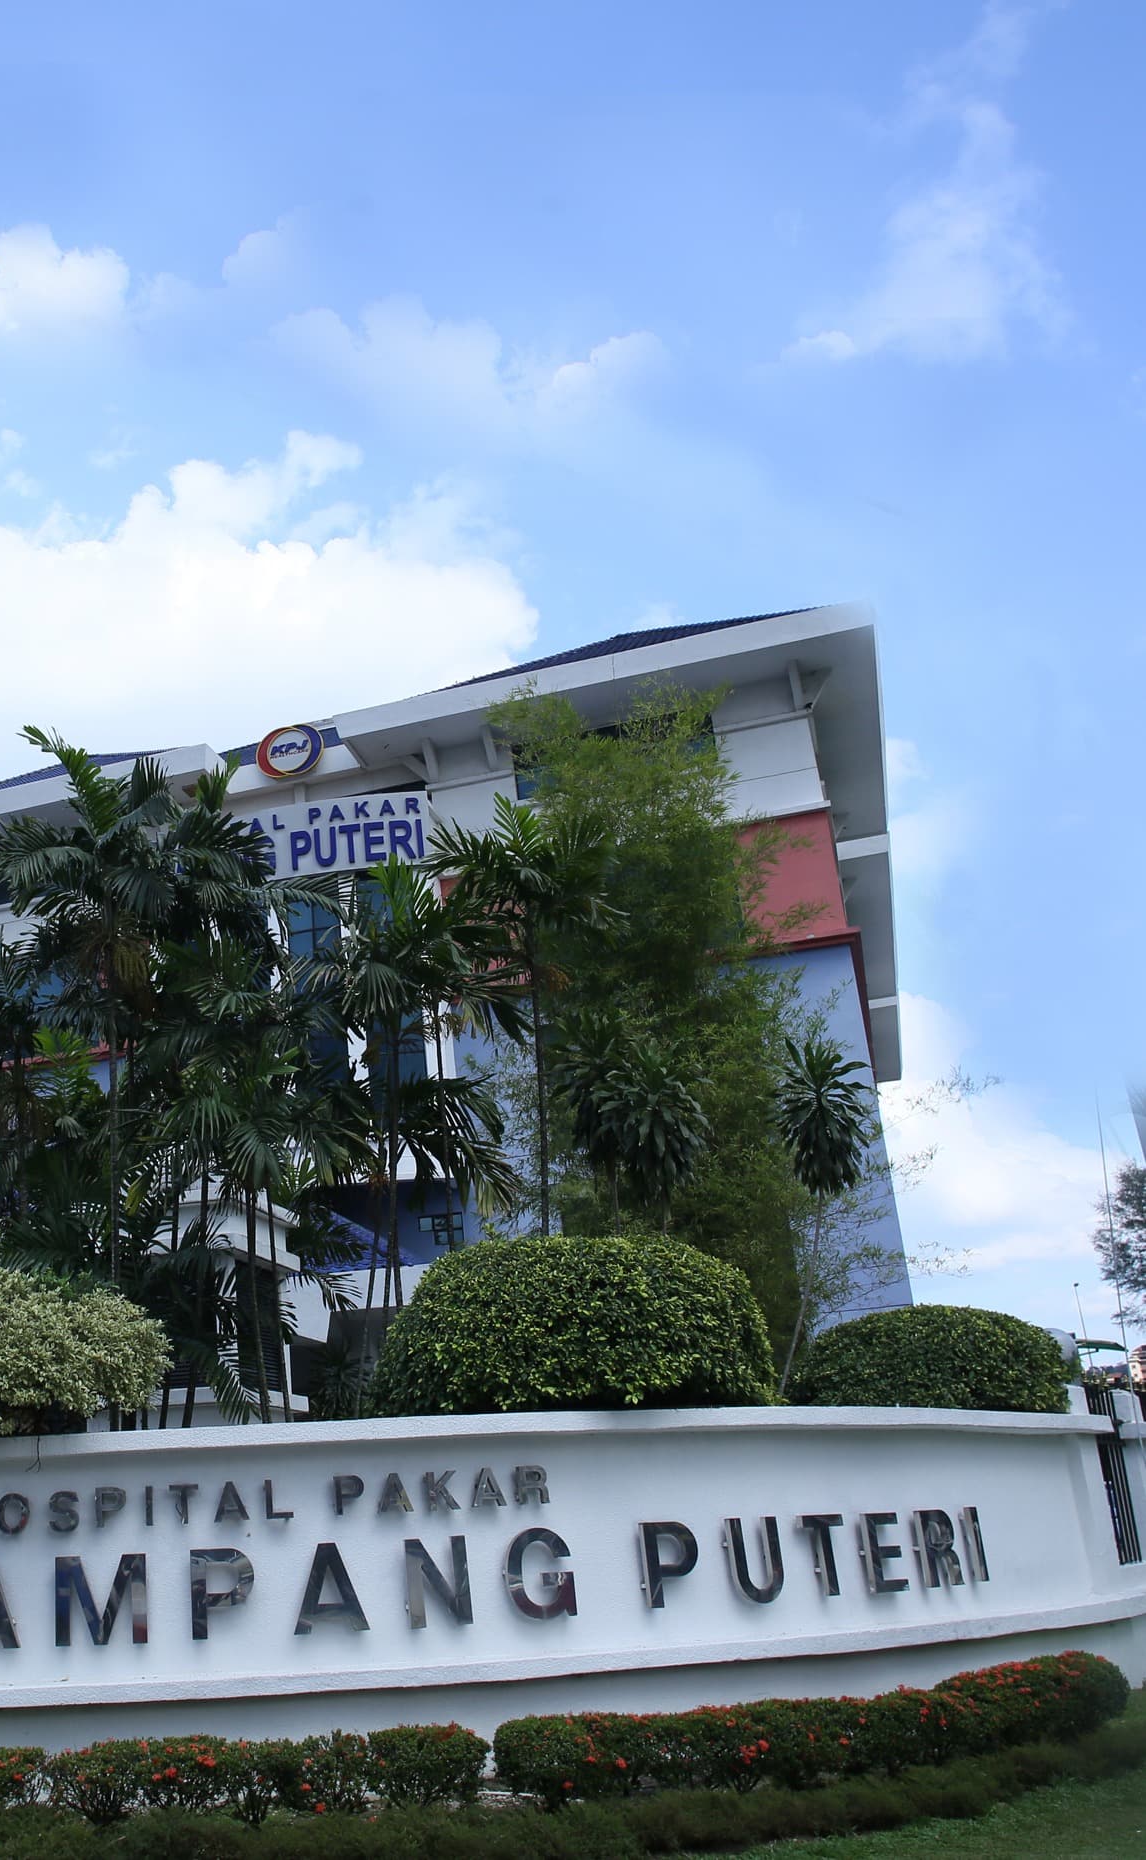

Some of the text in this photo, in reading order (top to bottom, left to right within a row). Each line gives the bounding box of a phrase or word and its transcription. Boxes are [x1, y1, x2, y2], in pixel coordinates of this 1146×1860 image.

[270, 739, 309, 756] KPJ
[308, 797, 421, 825] PAKAR
[290, 818, 425, 871] PUTERI
[332, 1464, 550, 1516] PAKAR
[638, 1505, 991, 1609] PUTERI
